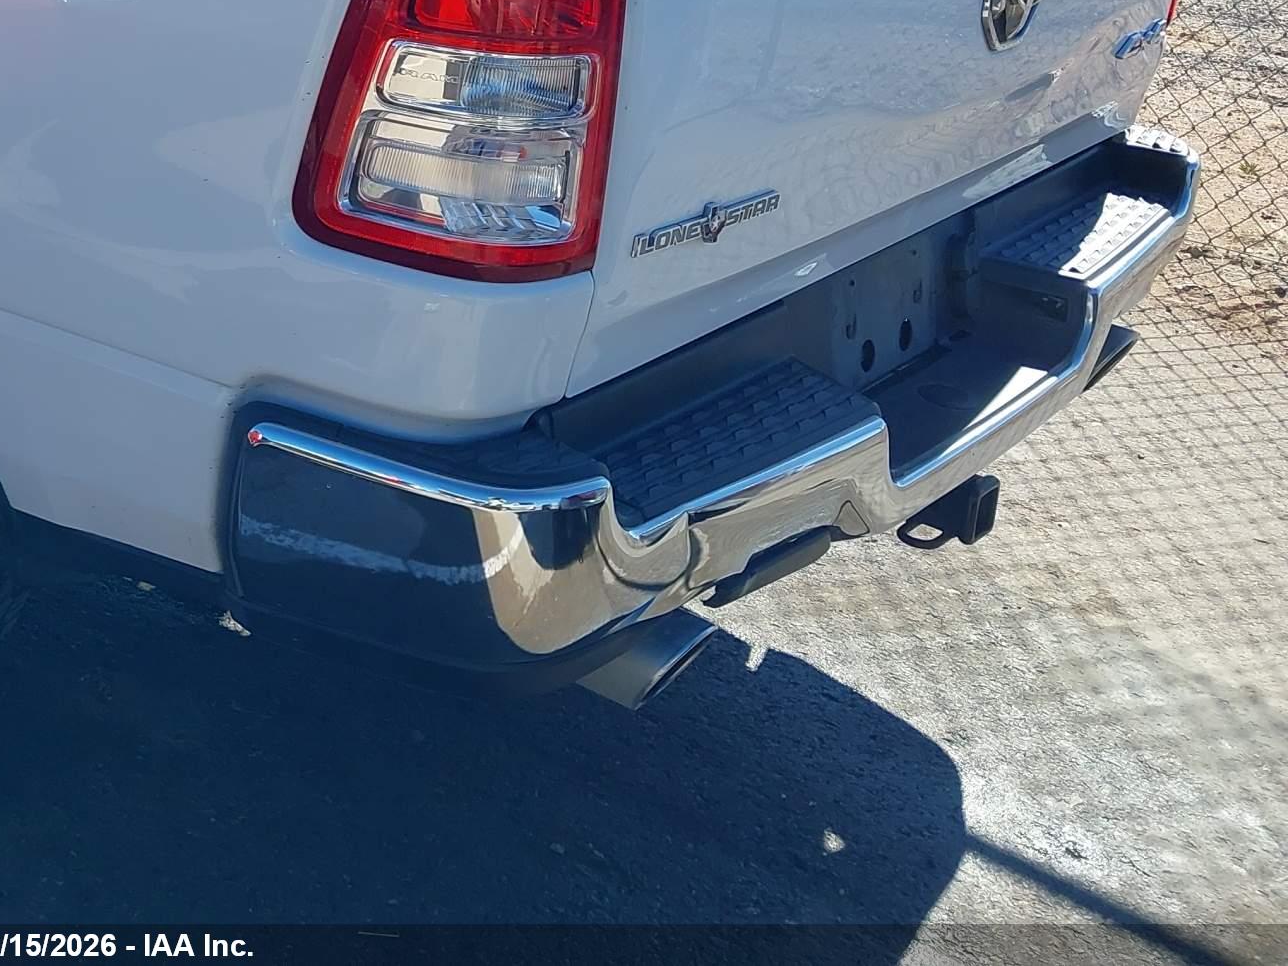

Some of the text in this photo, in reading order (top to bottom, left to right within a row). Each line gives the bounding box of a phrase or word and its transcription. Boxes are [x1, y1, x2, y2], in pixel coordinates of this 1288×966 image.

[399, 67, 460, 85] RAM
[637, 192, 781, 257] LONE STAR
